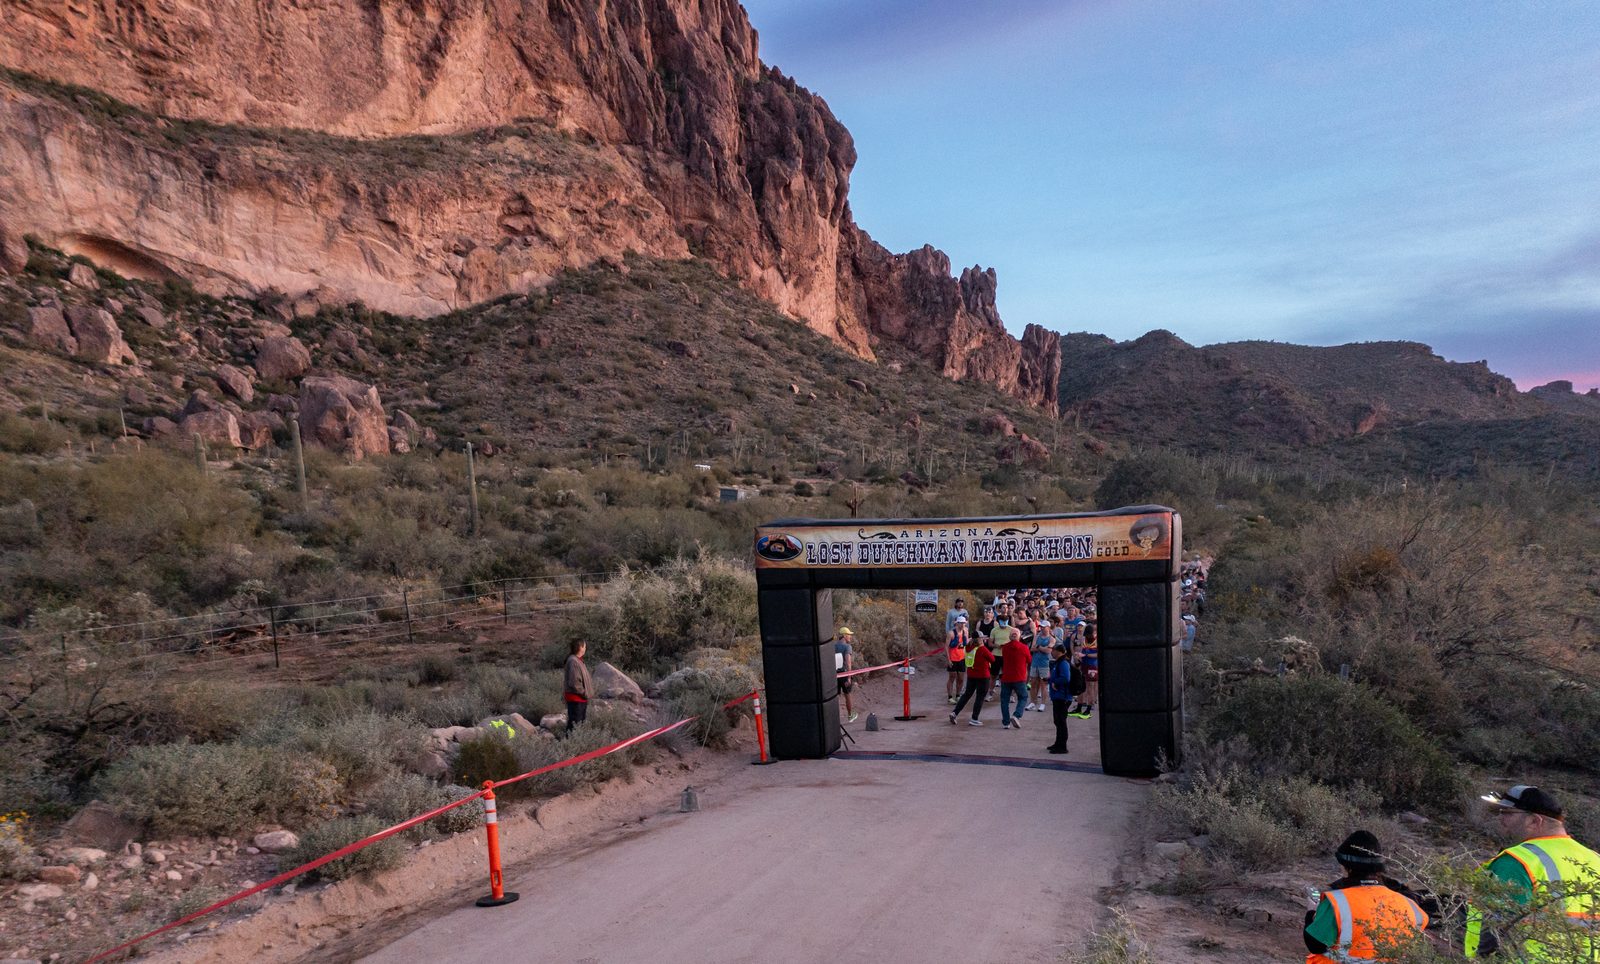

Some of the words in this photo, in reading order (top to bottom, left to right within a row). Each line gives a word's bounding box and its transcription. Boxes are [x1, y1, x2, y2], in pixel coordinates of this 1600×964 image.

[901, 528, 994, 538] ARIZONA
[806, 542, 854, 565] LOST
[858, 540, 966, 565] DUTCHMAN
[971, 536, 1093, 562] MARATHON
